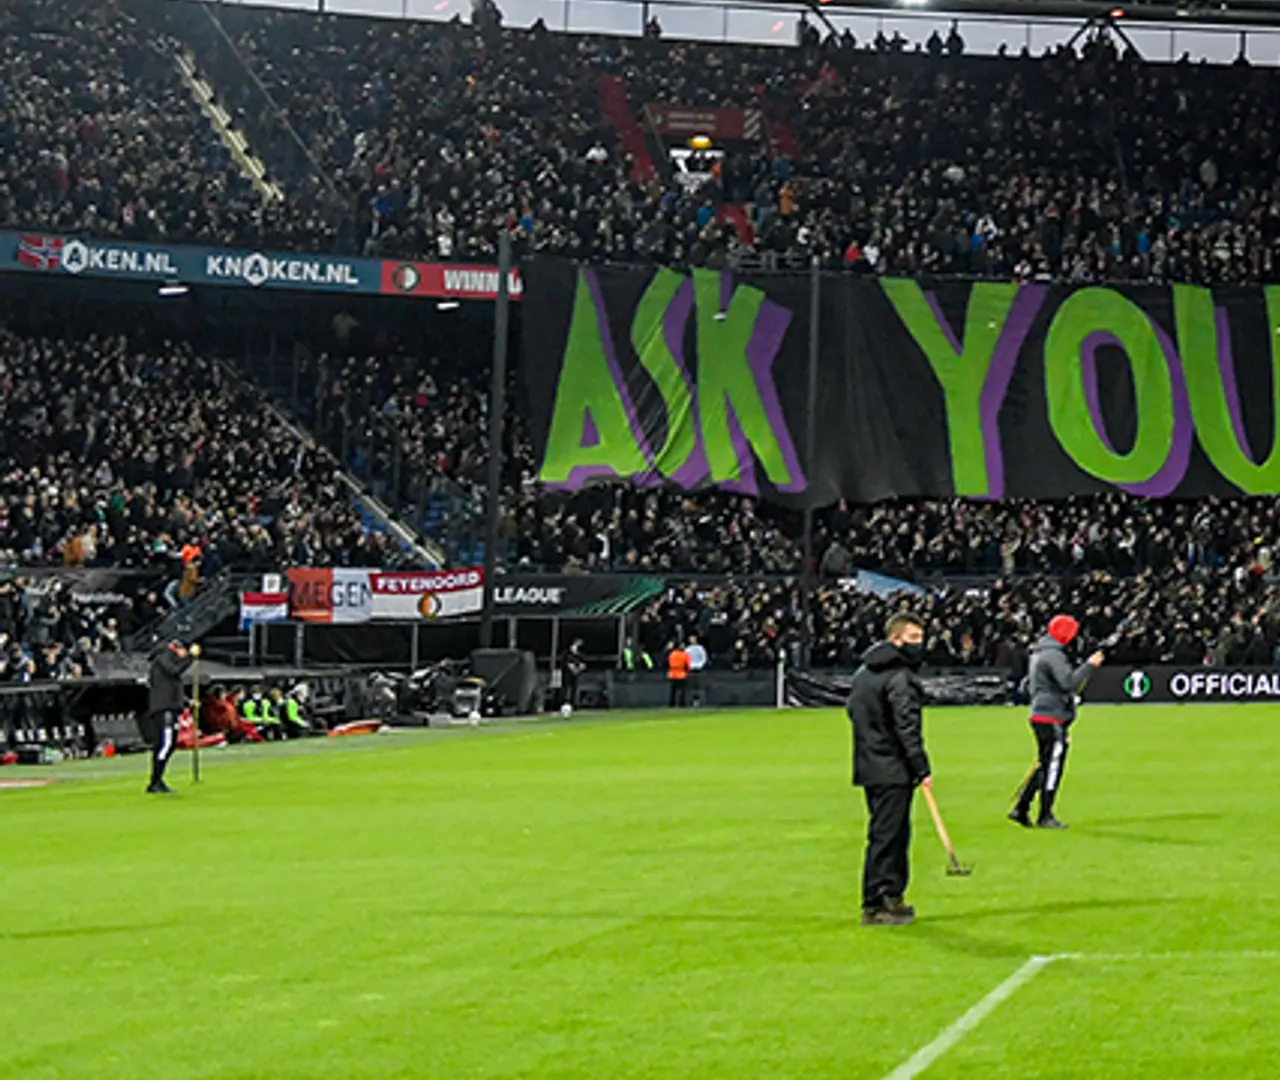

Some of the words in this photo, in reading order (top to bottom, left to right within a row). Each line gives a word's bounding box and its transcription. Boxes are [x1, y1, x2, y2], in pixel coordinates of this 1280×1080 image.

[61, 239, 178, 274] AKEN.NL
[206, 253, 359, 285] KNAKEN.NL
[538, 266, 806, 496] ASK
[494, 587, 561, 603] LEAGUE
